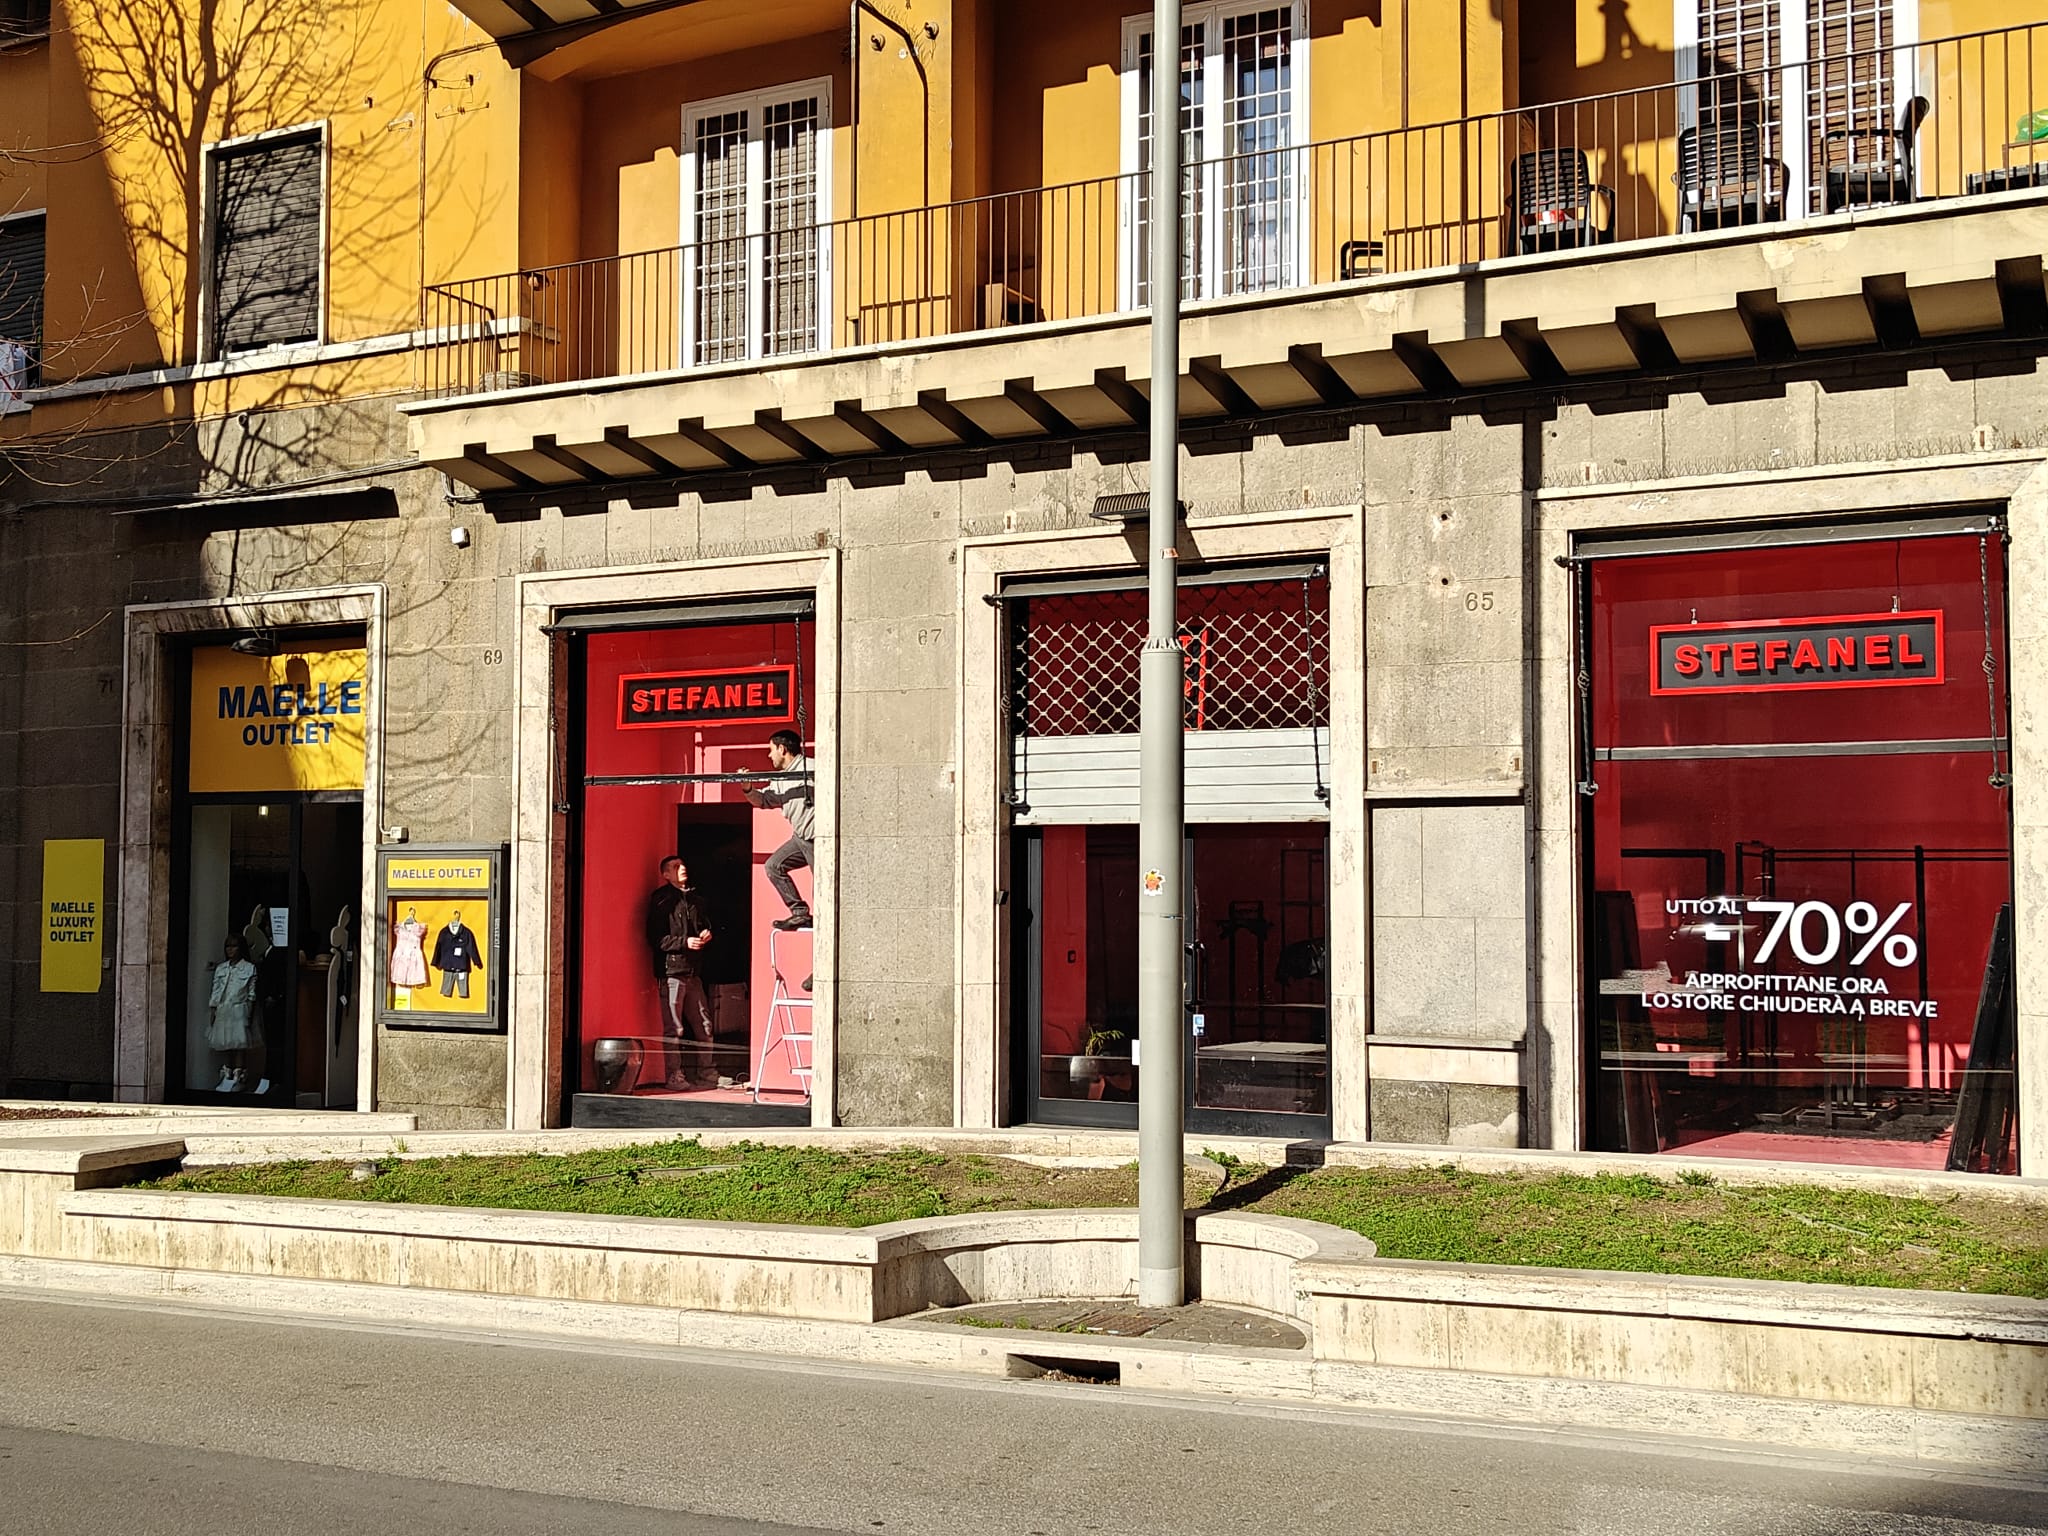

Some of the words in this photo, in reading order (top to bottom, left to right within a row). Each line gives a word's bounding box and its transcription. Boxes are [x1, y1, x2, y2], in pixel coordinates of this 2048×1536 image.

[1465, 591, 1494, 611] 65
[918, 628, 942, 646] 67
[484, 649, 502, 665] 69
[1674, 634, 1923, 674] STEFANEL
[218, 681, 361, 718] MAELLE
[631, 682, 782, 713] STEFANEL
[243, 722, 334, 746] OUTLET
[392, 868, 435, 879] MAELLE
[438, 868, 482, 879] OUTLET
[51, 902, 95, 913] MAELLE
[1666, 899, 1715, 914] UTTO
[1717, 900, 1742, 915] AL
[50, 916, 95, 928] LUXURY
[50, 930, 95, 942] OUTLET
[1685, 973, 1837, 994] APPROFITTANE
[1842, 976, 1889, 995] ORA
[1641, 991, 1669, 1009] LO
[1671, 993, 1735, 1011] STORE
[1739, 994, 1846, 1016] CHIUDERÀ
[1870, 1000, 1938, 1018] BREVE
